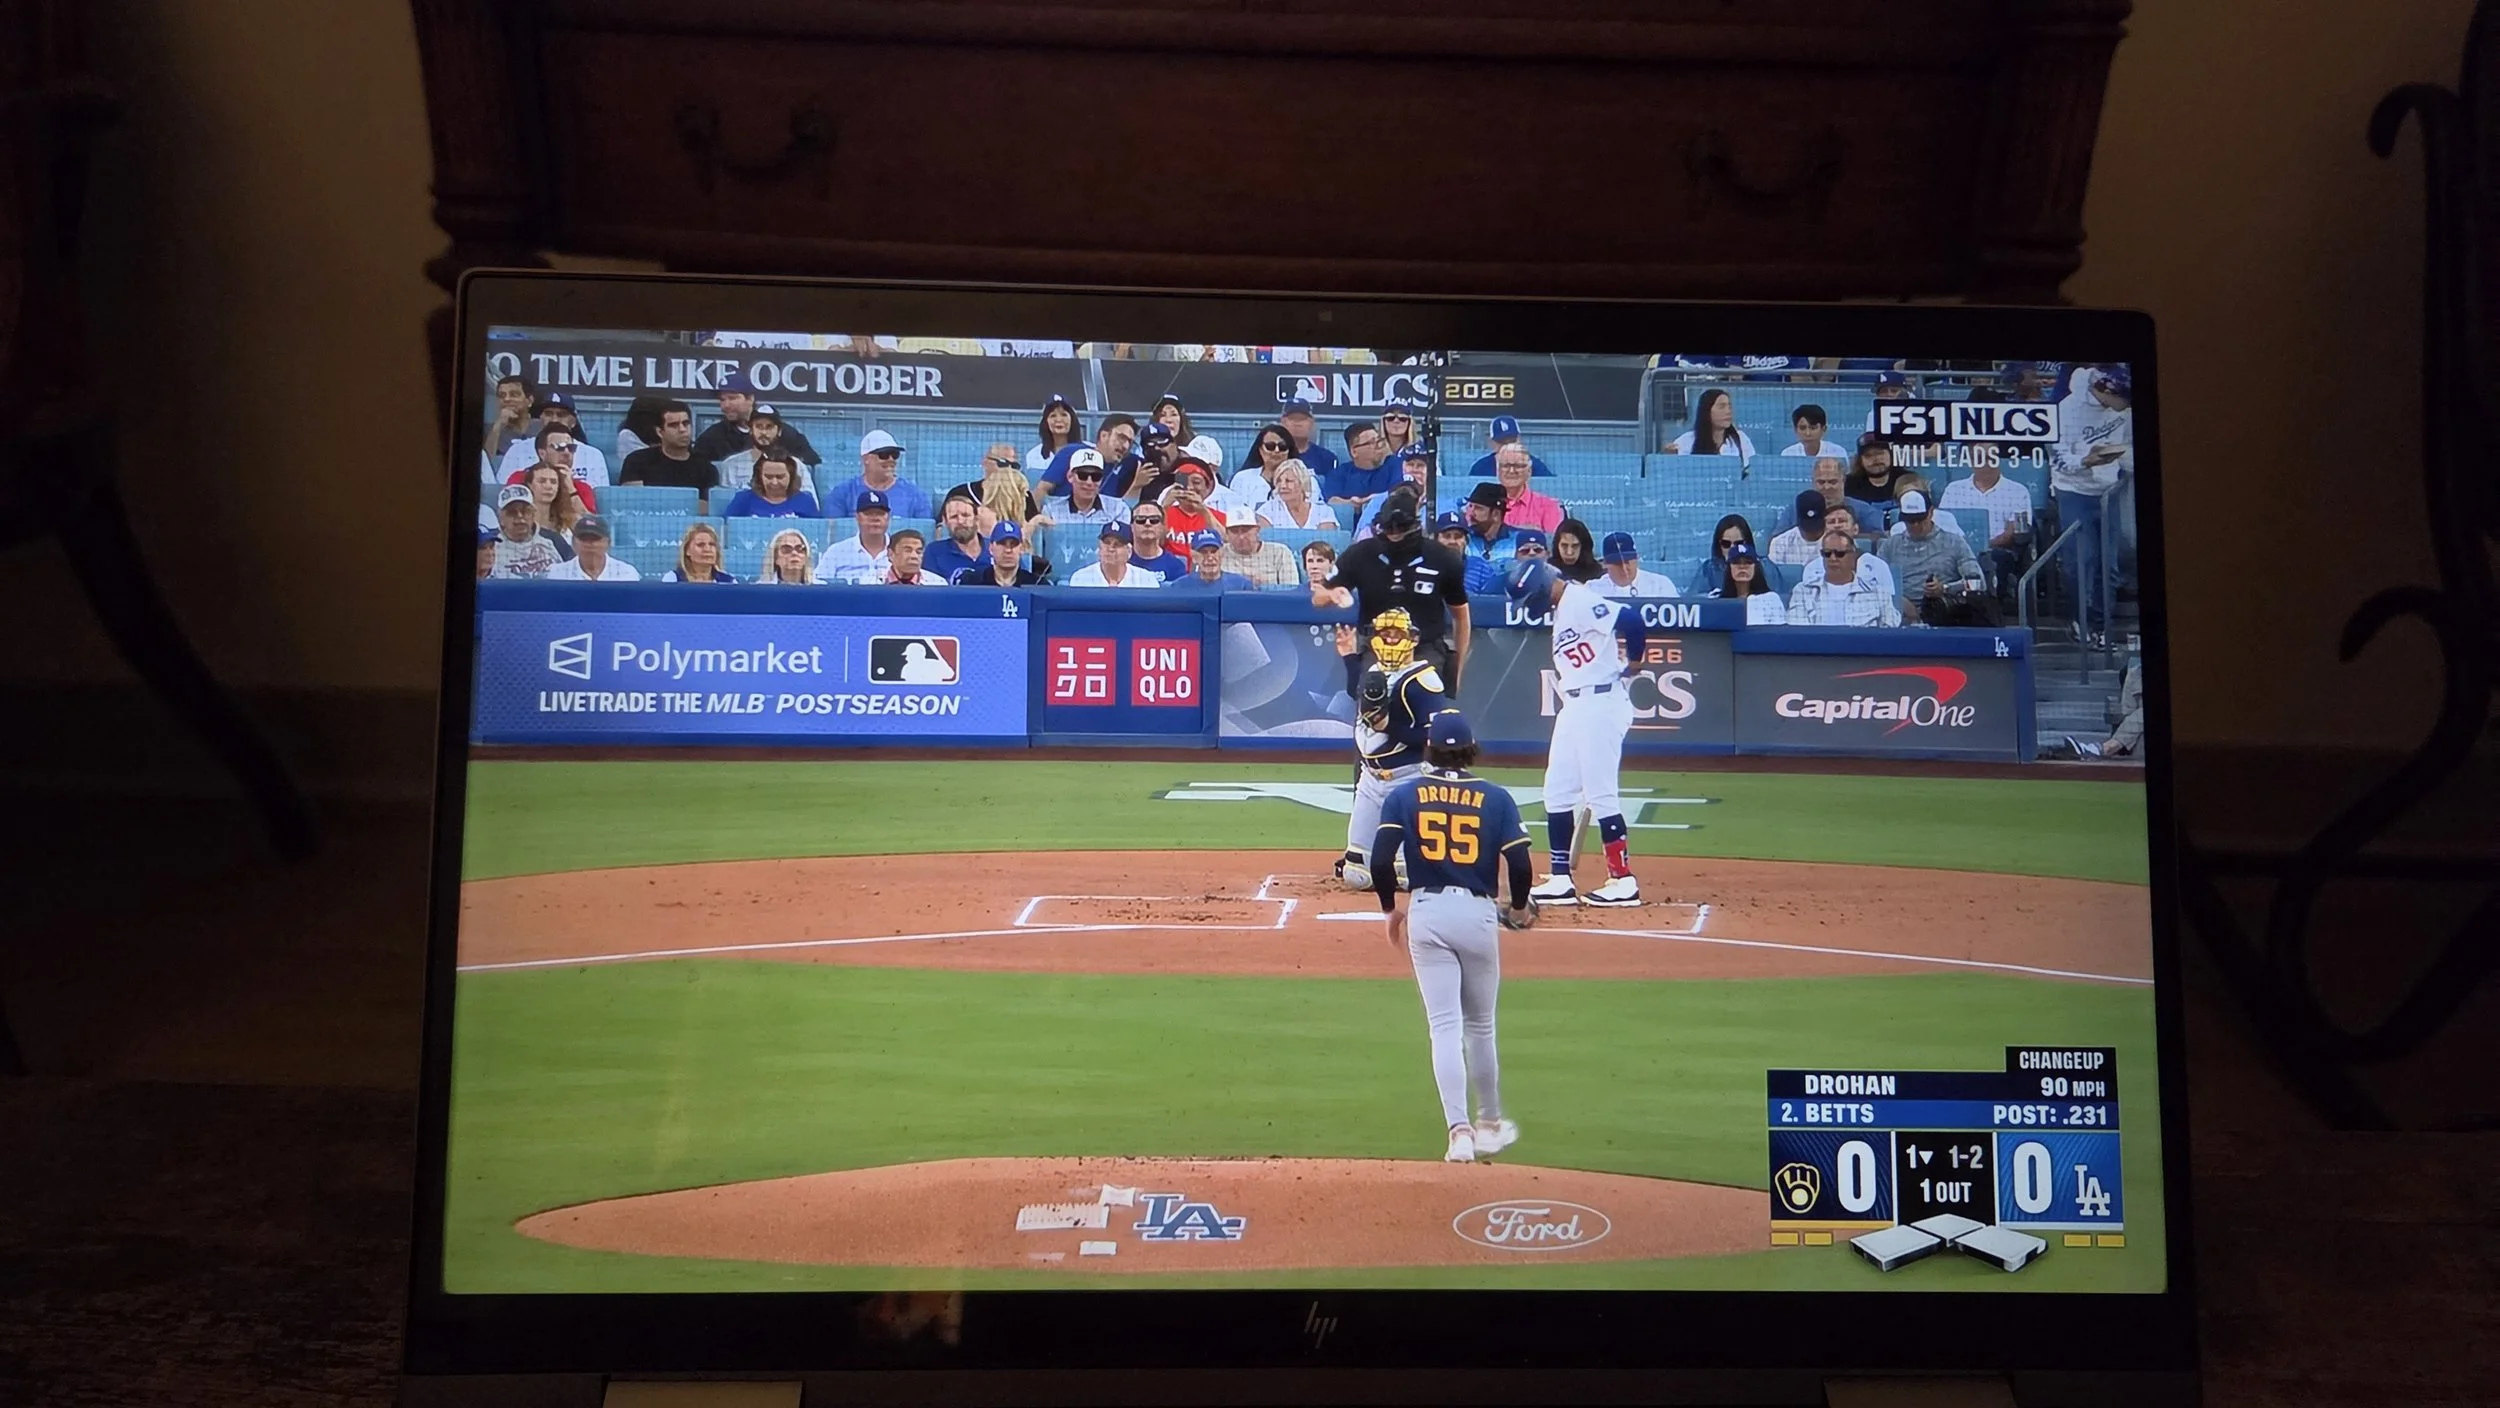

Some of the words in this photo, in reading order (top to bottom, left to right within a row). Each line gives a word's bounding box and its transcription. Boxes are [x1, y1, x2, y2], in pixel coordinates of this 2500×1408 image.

[530, 353, 633, 388] TIME
[749, 360, 944, 398] OCTOBER
[1332, 373, 1438, 407] NLCS
[1445, 383, 1515, 399] 2026
[1880, 405, 1946, 436] FS1
[1959, 407, 2051, 437] NLCS
[1892, 443, 1930, 468] MIL
[1937, 444, 2000, 469] LEADS
[2008, 445, 2044, 469] 3-0
[1001, 594, 1018, 618] LA
[1563, 641, 1596, 669] 50
[1994, 636, 2009, 657] LA
[612, 640, 823, 680] Polymarket
[1139, 647, 1188, 672] UNI
[1139, 675, 1192, 703] QLO
[539, 691, 657, 713] LIVETRADE
[661, 692, 702, 713] THE
[706, 693, 765, 714] MLB
[775, 693, 961, 716] POSTSEASON
[1417, 785, 1485, 809] DROHAN
[1417, 811, 1481, 865] 55
[2019, 1050, 2104, 1072] CHANGEUP
[1804, 1074, 1896, 1096] DROHAN
[2040, 1076, 2068, 1097] 90
[2073, 1080, 2105, 1097] MPH
[1781, 1103, 1799, 1124] 2.
[1805, 1103, 1875, 1124] BETTS
[1993, 1104, 2057, 1125] POST:
[2063, 1105, 2107, 1126] .231
[1949, 1144, 1984, 1169] 1-2
[1837, 1140, 1877, 1213] 0
[2013, 1141, 2053, 1214] 0
[1919, 1178, 1931, 1203] 1
[1936, 1181, 1973, 1203] OUT
[2074, 1164, 2111, 1217] LA
[1132, 1193, 1247, 1241] LA
[1484, 1207, 1584, 1243] Ford
